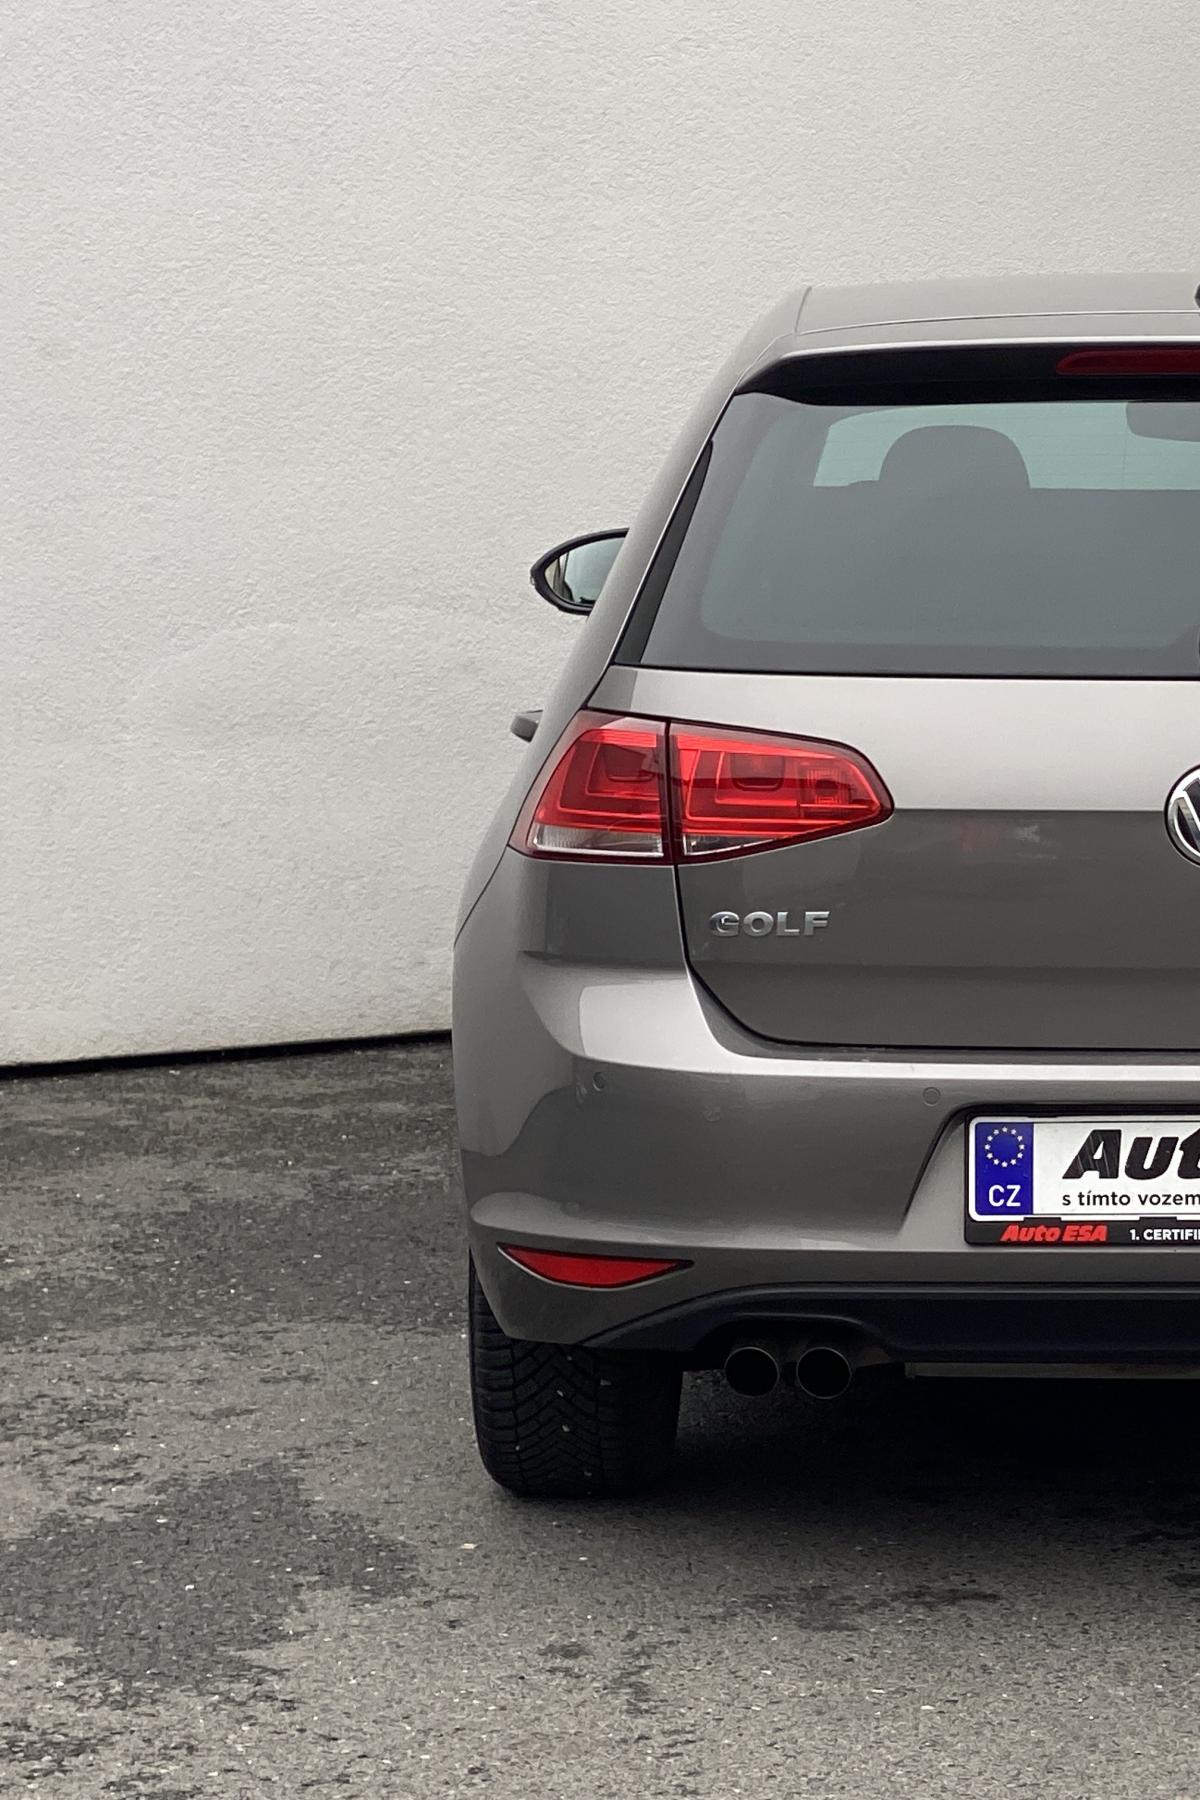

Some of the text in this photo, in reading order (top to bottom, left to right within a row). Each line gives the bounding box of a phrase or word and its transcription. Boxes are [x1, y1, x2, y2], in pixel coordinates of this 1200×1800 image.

[709, 911, 830, 937] GOLF
[988, 1184, 1021, 1207] CZ
[1062, 1194, 1071, 1206] s
[1078, 1190, 1131, 1206] tímto
[1001, 1225, 1108, 1242] Auto ESA
[1129, 1229, 1140, 1241] 1.
